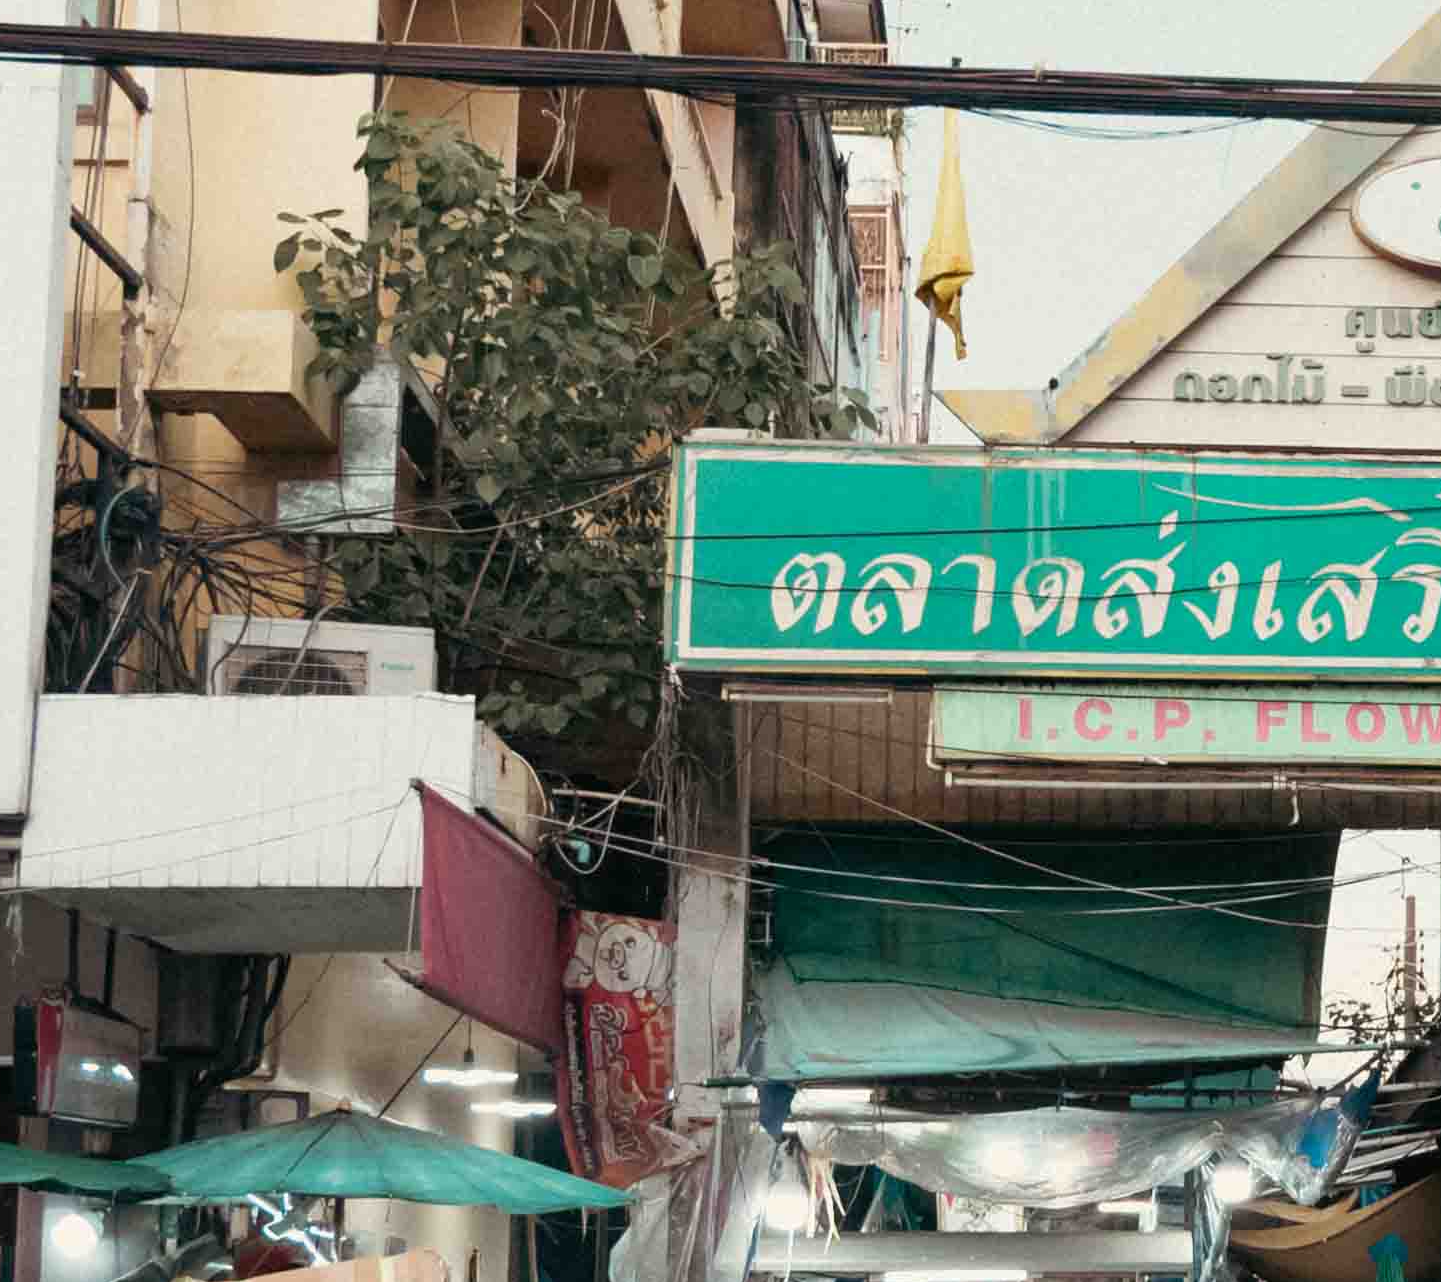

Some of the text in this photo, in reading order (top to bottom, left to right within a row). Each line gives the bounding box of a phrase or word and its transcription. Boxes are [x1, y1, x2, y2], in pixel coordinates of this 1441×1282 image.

[1173, 353, 1324, 405] ดอกไม้
[1016, 697, 1218, 745] I.C.P.
